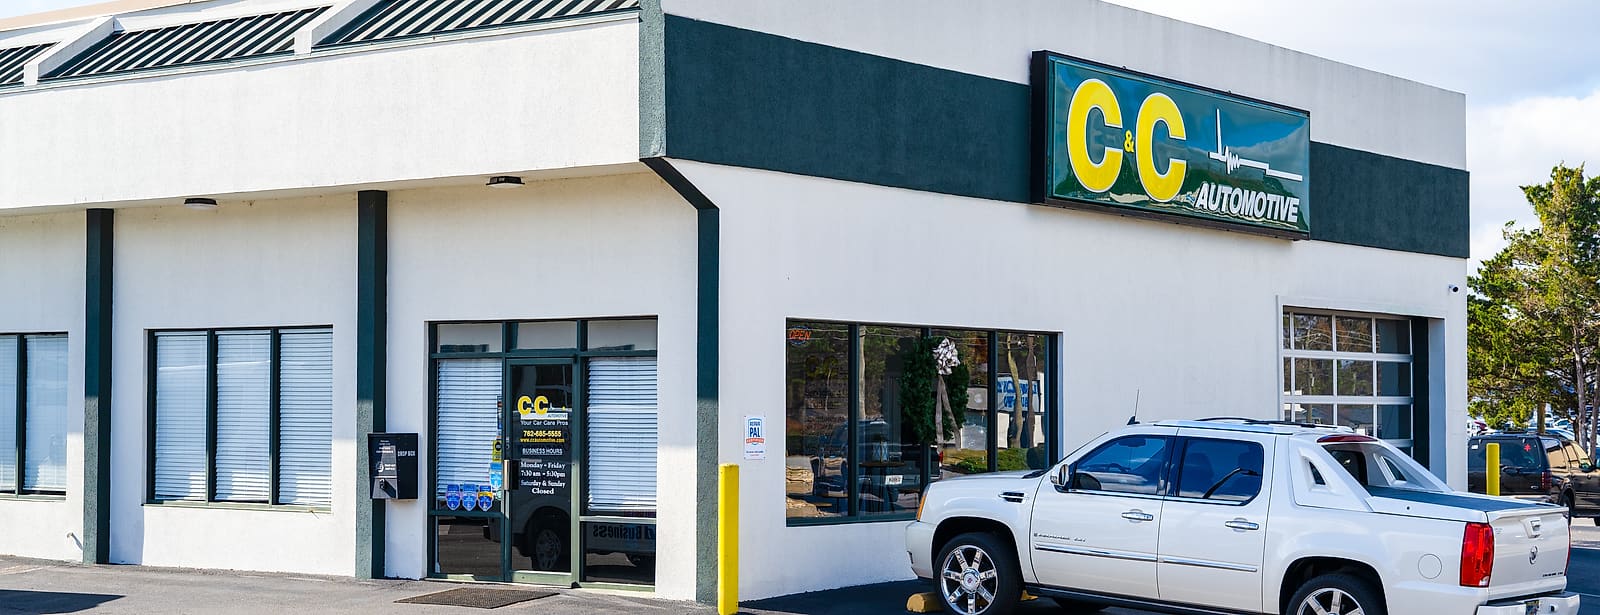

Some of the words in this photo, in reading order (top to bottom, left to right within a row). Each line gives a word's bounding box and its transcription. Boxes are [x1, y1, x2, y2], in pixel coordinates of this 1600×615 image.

[1195, 181, 1300, 222] AUTOMOTIVE
[789, 329, 811, 340] OPEN
[750, 427, 760, 438] PAL
